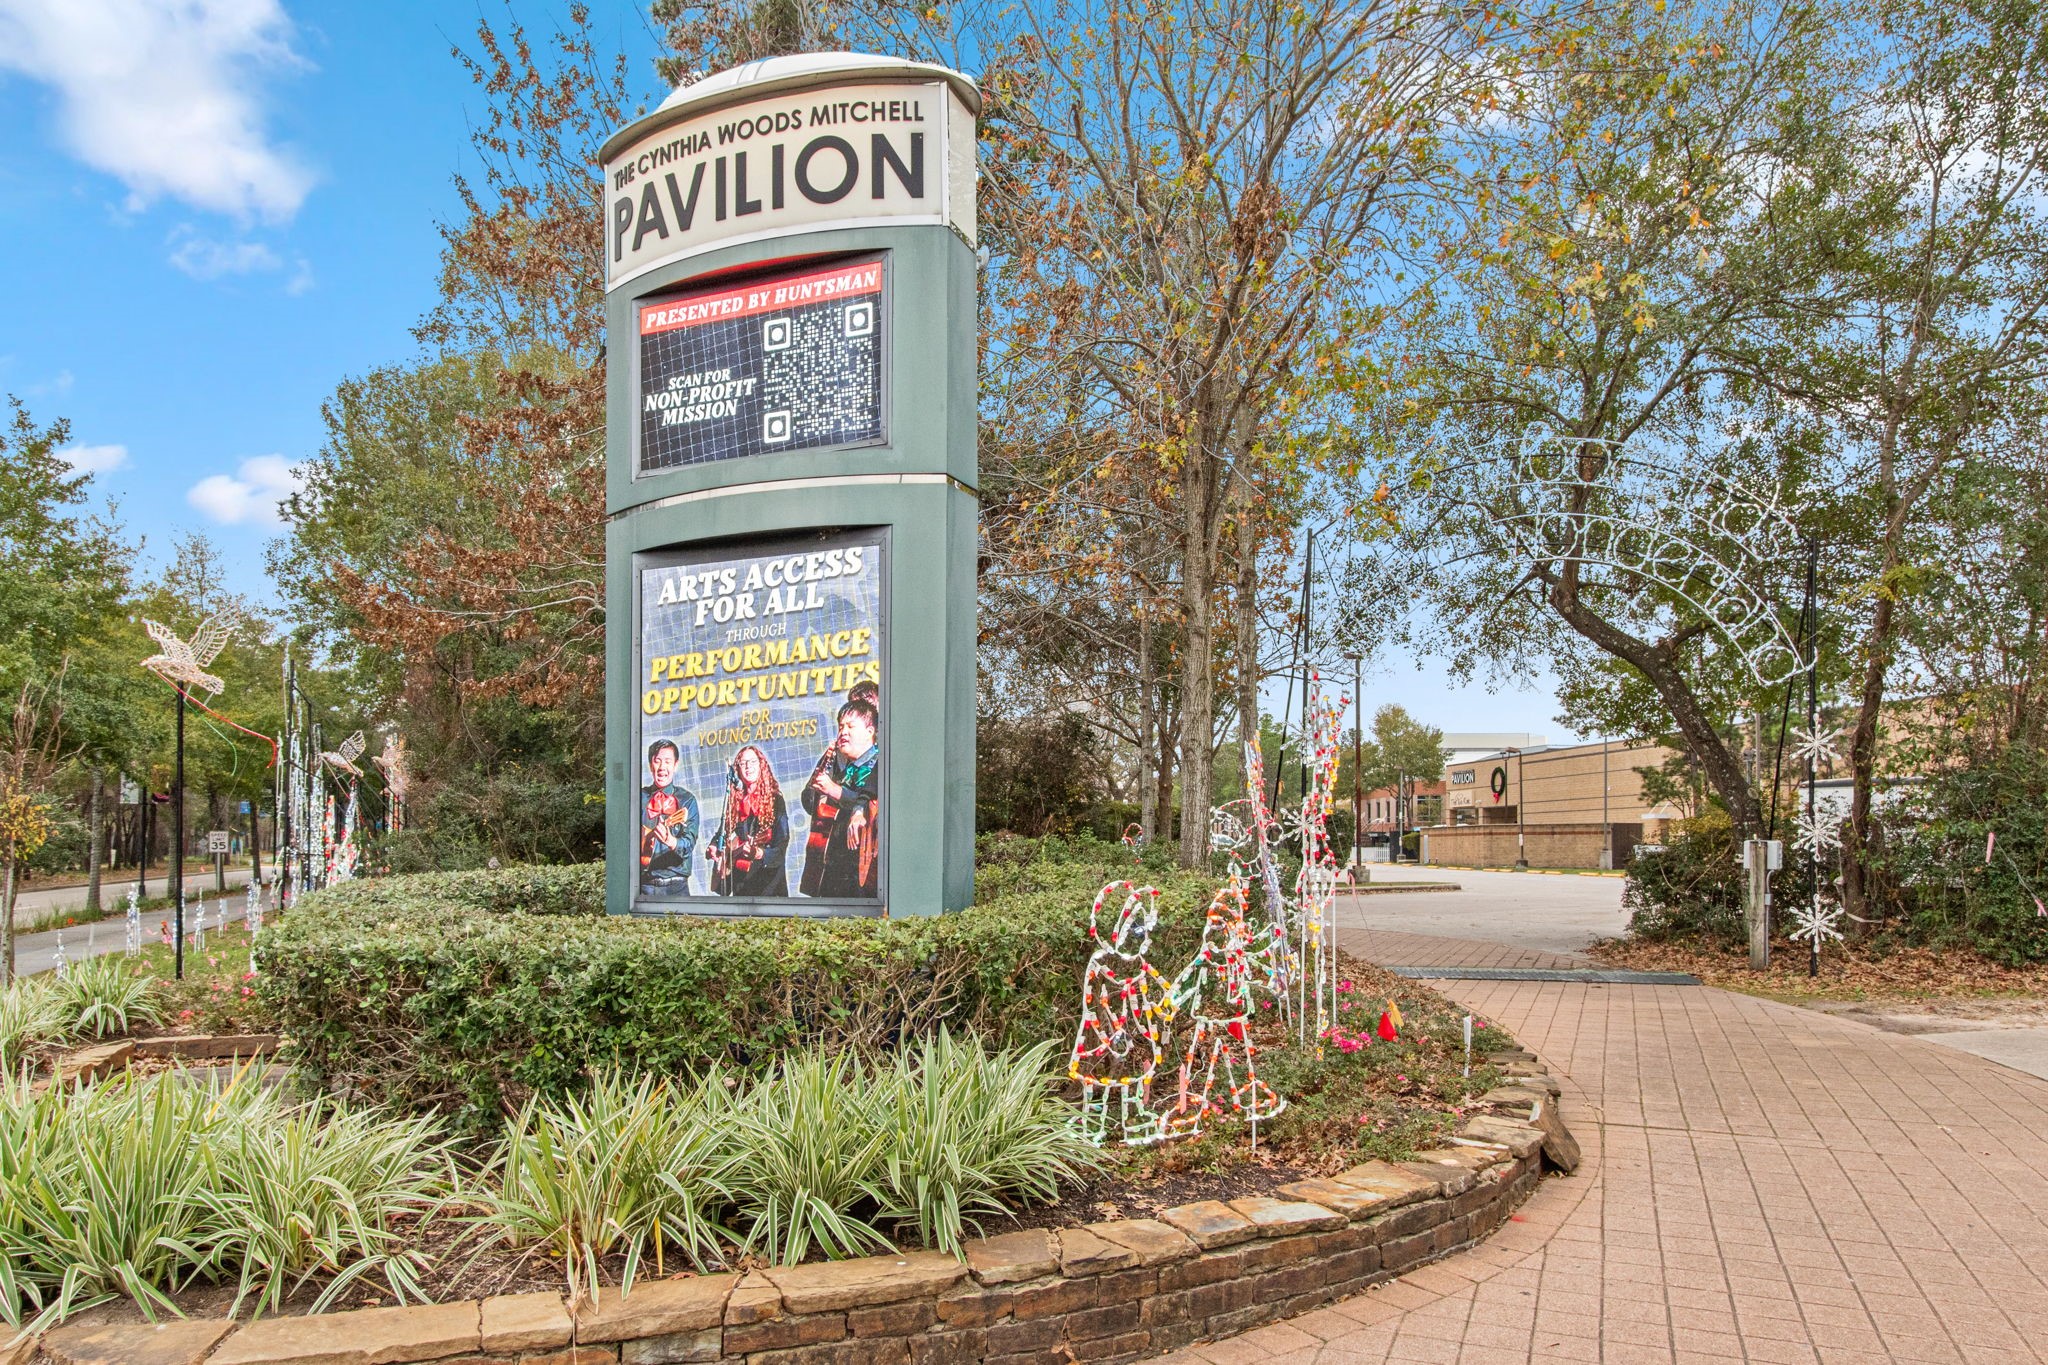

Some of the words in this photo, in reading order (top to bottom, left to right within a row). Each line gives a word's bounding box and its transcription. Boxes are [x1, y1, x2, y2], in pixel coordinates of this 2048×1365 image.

[614, 160, 635, 191] THE
[637, 131, 712, 175] CYNTHIA
[718, 109, 802, 145] WOODS
[809, 100, 925, 127] MITCHELL
[614, 132, 925, 262] PAVILION
[645, 296, 744, 329] PRESENTED
[747, 290, 772, 310] BY
[774, 270, 878, 304] HUNTSMAN
[645, 377, 757, 412] NON-PROFIT
[668, 374, 702, 391] SCAN
[704, 369, 731, 384] FOR
[661, 399, 738, 427] MISSION
[657, 567, 737, 606] ARTS
[742, 547, 863, 591] ACCESS
[694, 593, 756, 626] FOR
[763, 582, 824, 616] ALL
[726, 622, 787, 643] THROUGH
[649, 627, 871, 683] PERFORMANCE
[642, 660, 880, 715] OPPORTUNITIES
[699, 726, 751, 748] YOUNG
[754, 718, 818, 743] ARTISTS
[741, 708, 771, 727] FOR
[211, 841, 226, 850] 35
